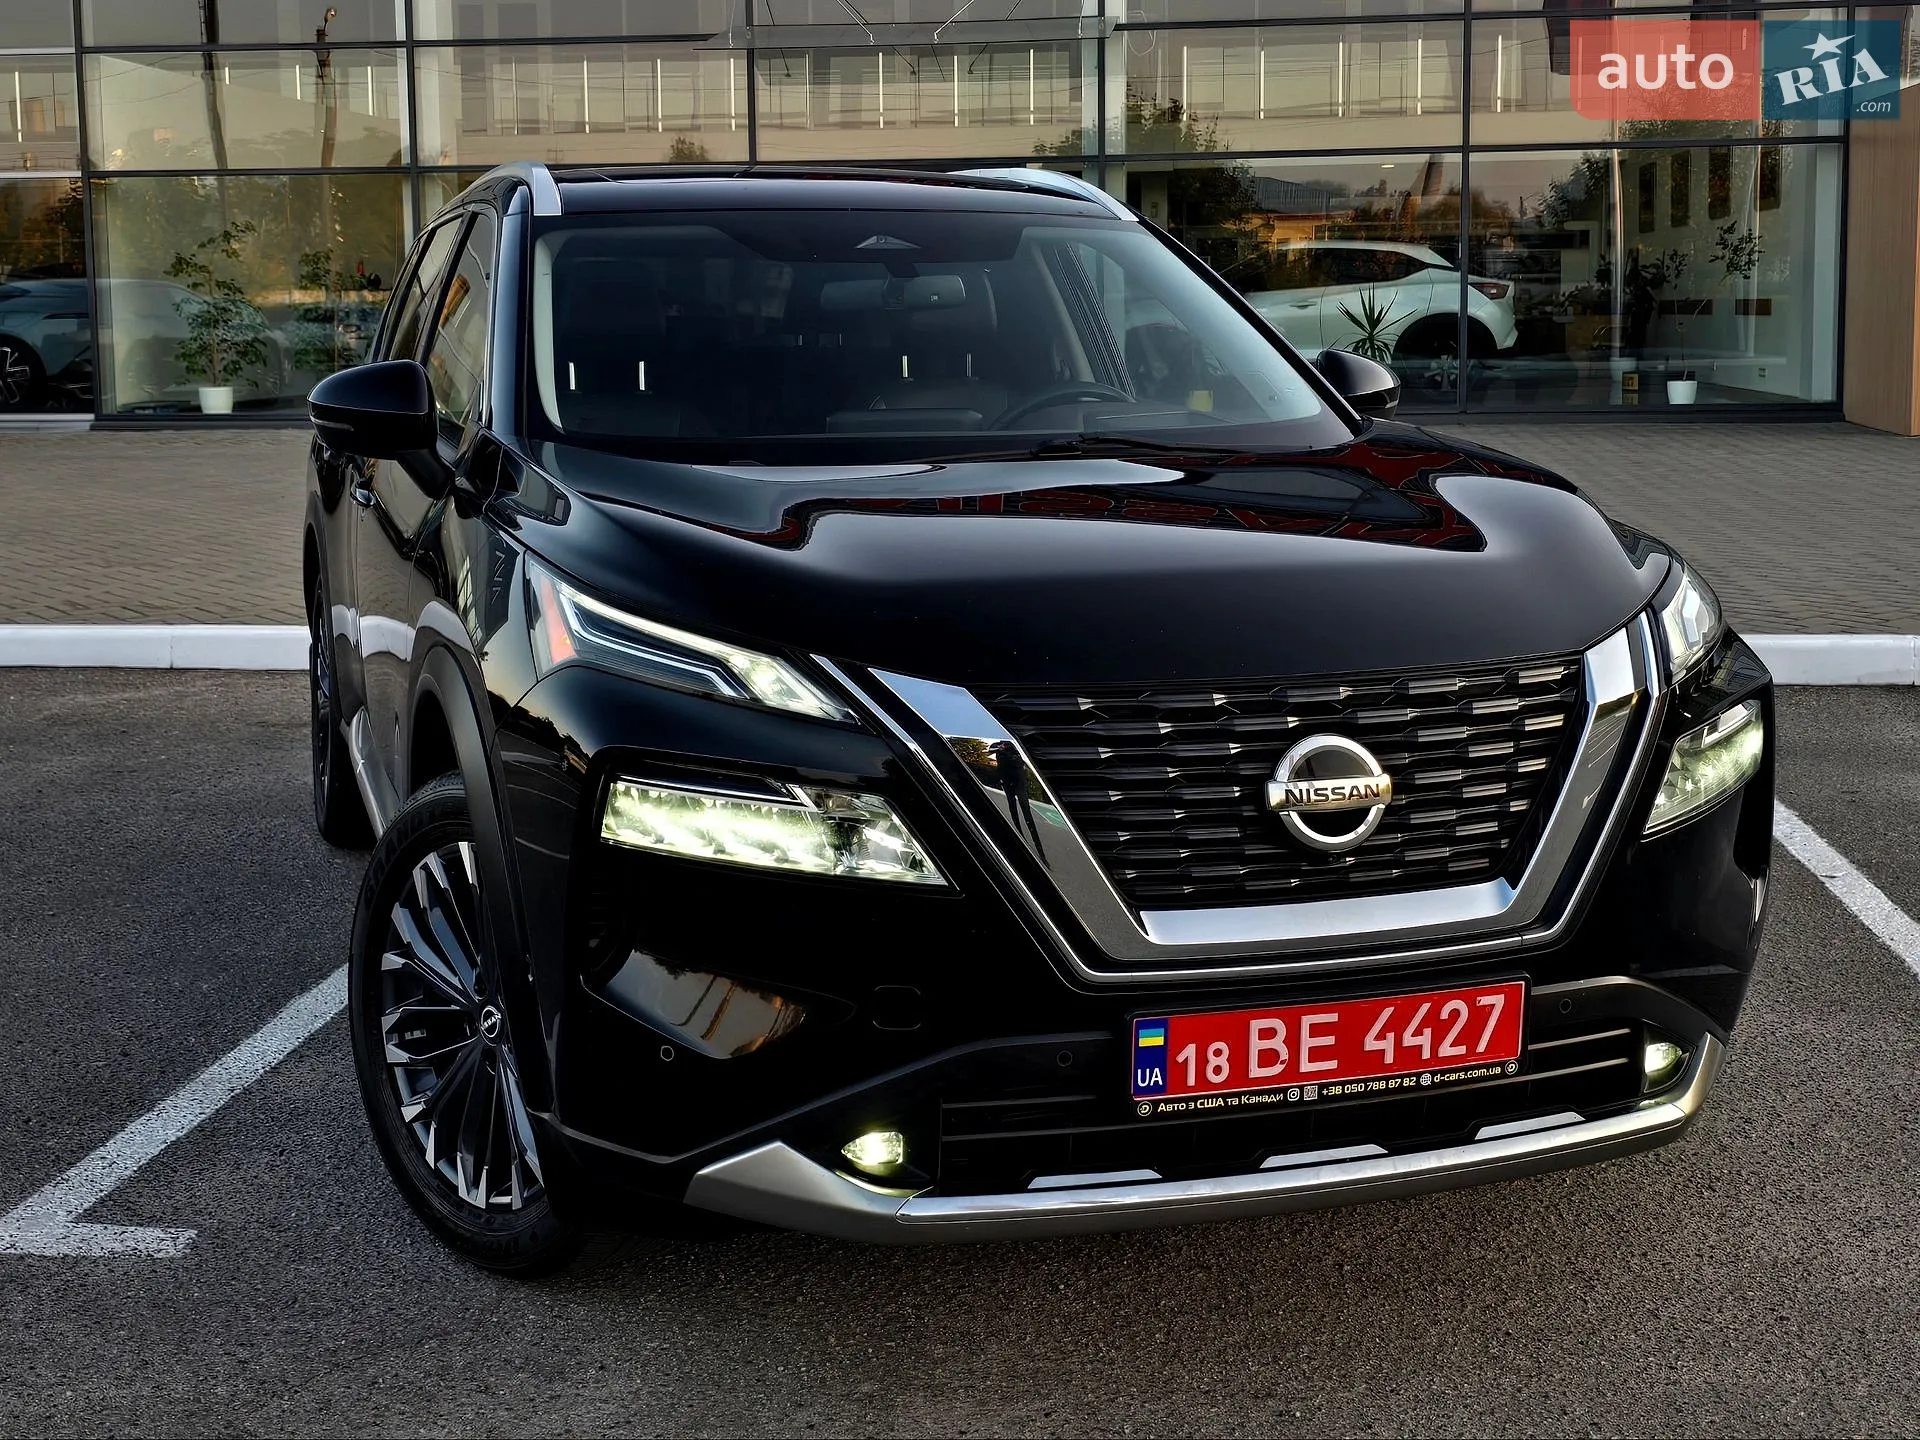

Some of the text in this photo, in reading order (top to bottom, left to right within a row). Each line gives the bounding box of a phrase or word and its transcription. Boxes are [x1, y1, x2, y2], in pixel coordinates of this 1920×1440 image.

[1284, 783, 1381, 806] NISSAN
[1175, 994, 1505, 1086] 18 BE 4427
[1137, 1067, 1163, 1087] UA
[1433, 1065, 1502, 1083] d-cars.com.ua
[1321, 1076, 1417, 1096] +38 050 788 87 82
[1157, 1102, 1186, 1113] Авто
[1197, 1097, 1225, 1109] США
[1226, 1097, 1239, 1106] та
[1241, 1093, 1284, 1104] Канади
